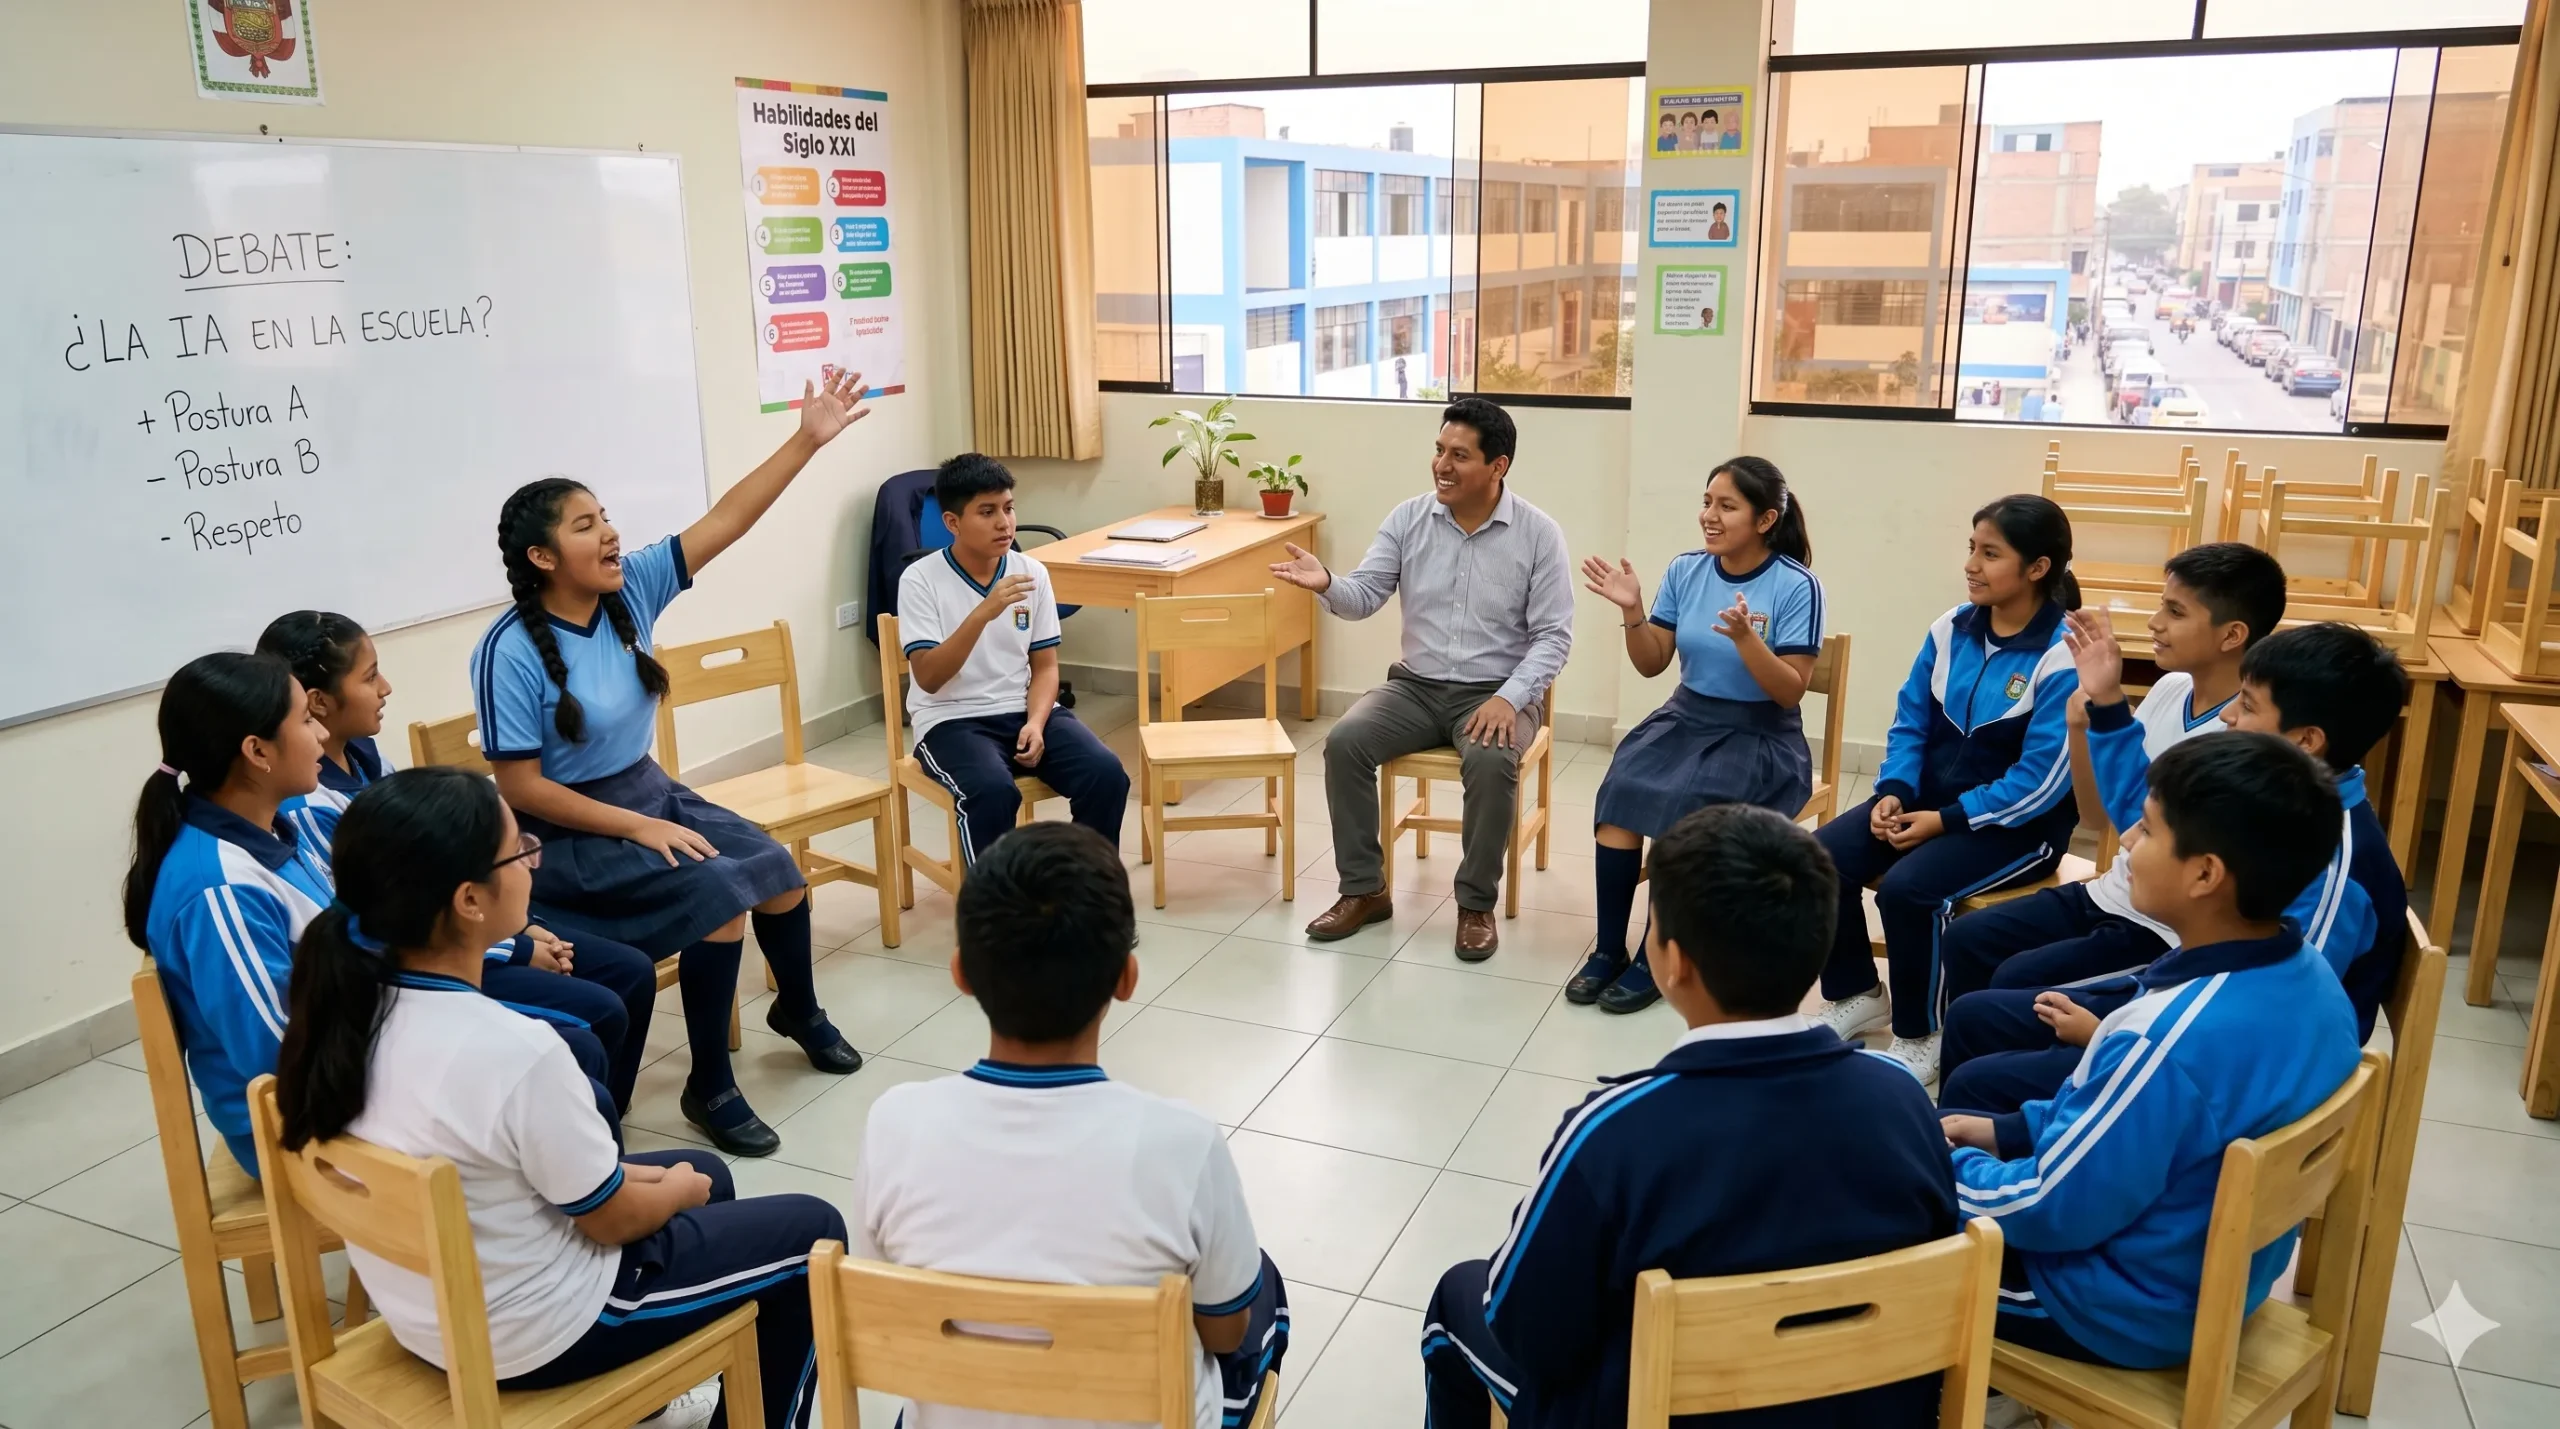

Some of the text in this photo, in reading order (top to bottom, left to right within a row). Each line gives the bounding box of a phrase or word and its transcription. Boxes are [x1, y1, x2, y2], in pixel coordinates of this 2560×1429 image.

[752, 102, 879, 132] Habilidades del
[783, 132, 856, 159] Siglo XXI
[831, 182, 837, 194] 2
[761, 230, 767, 242] 4
[172, 232, 353, 280] DEBATE:
[765, 280, 771, 292] 5
[65, 294, 493, 372] ¿LA IA EN LA ESCUELA?
[164, 389, 273, 434] Postura
[288, 384, 309, 422] A
[174, 445, 283, 490] Postura
[293, 437, 320, 475] B
[183, 500, 303, 556] Respeto
